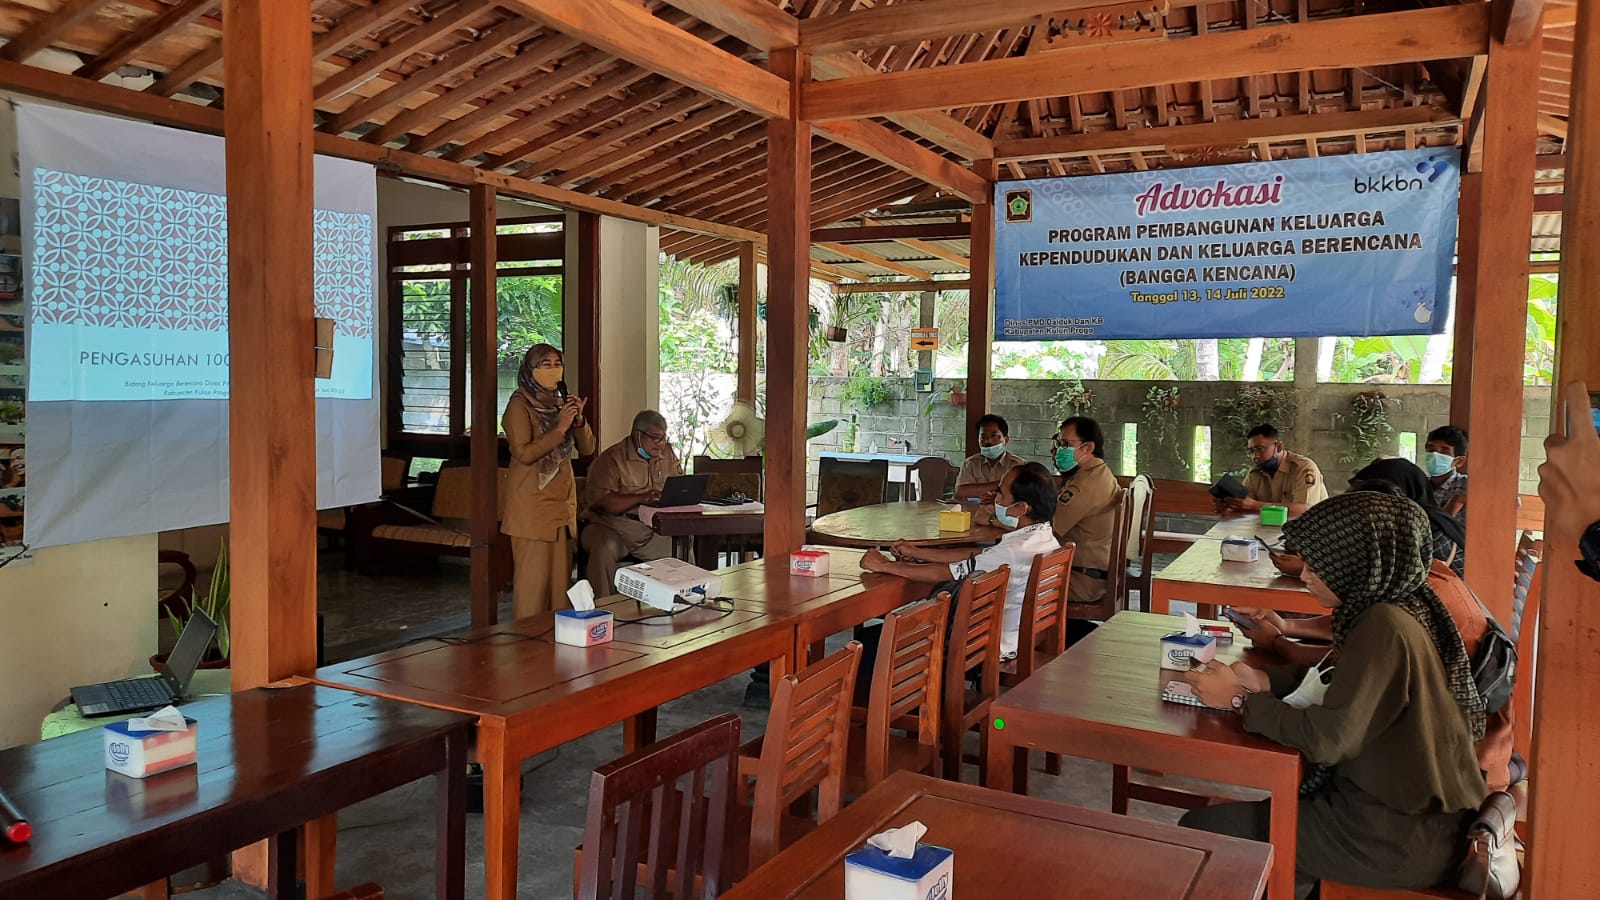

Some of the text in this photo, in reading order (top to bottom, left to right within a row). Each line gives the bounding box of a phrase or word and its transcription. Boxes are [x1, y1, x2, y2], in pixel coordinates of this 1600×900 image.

[1354, 174, 1422, 193] bkkbn
[1136, 175, 1282, 217] Advokasi
[1048, 210, 1385, 244] PROGRAM PEMBANGUNAN KELUARGA
[1019, 232, 1422, 266] KEPENDUDUKAN DAN KELUARGA BERENCANA
[1119, 264, 1296, 288] (BANGGA KENCANA)
[1131, 287, 1285, 304] Tanggal 13, 14 Juli 2022
[1091, 316, 1105, 325] KB
[1004, 326, 1095, 336] Kabupaten Kulon Progo
[79, 350, 199, 367] PENGASUHAN
